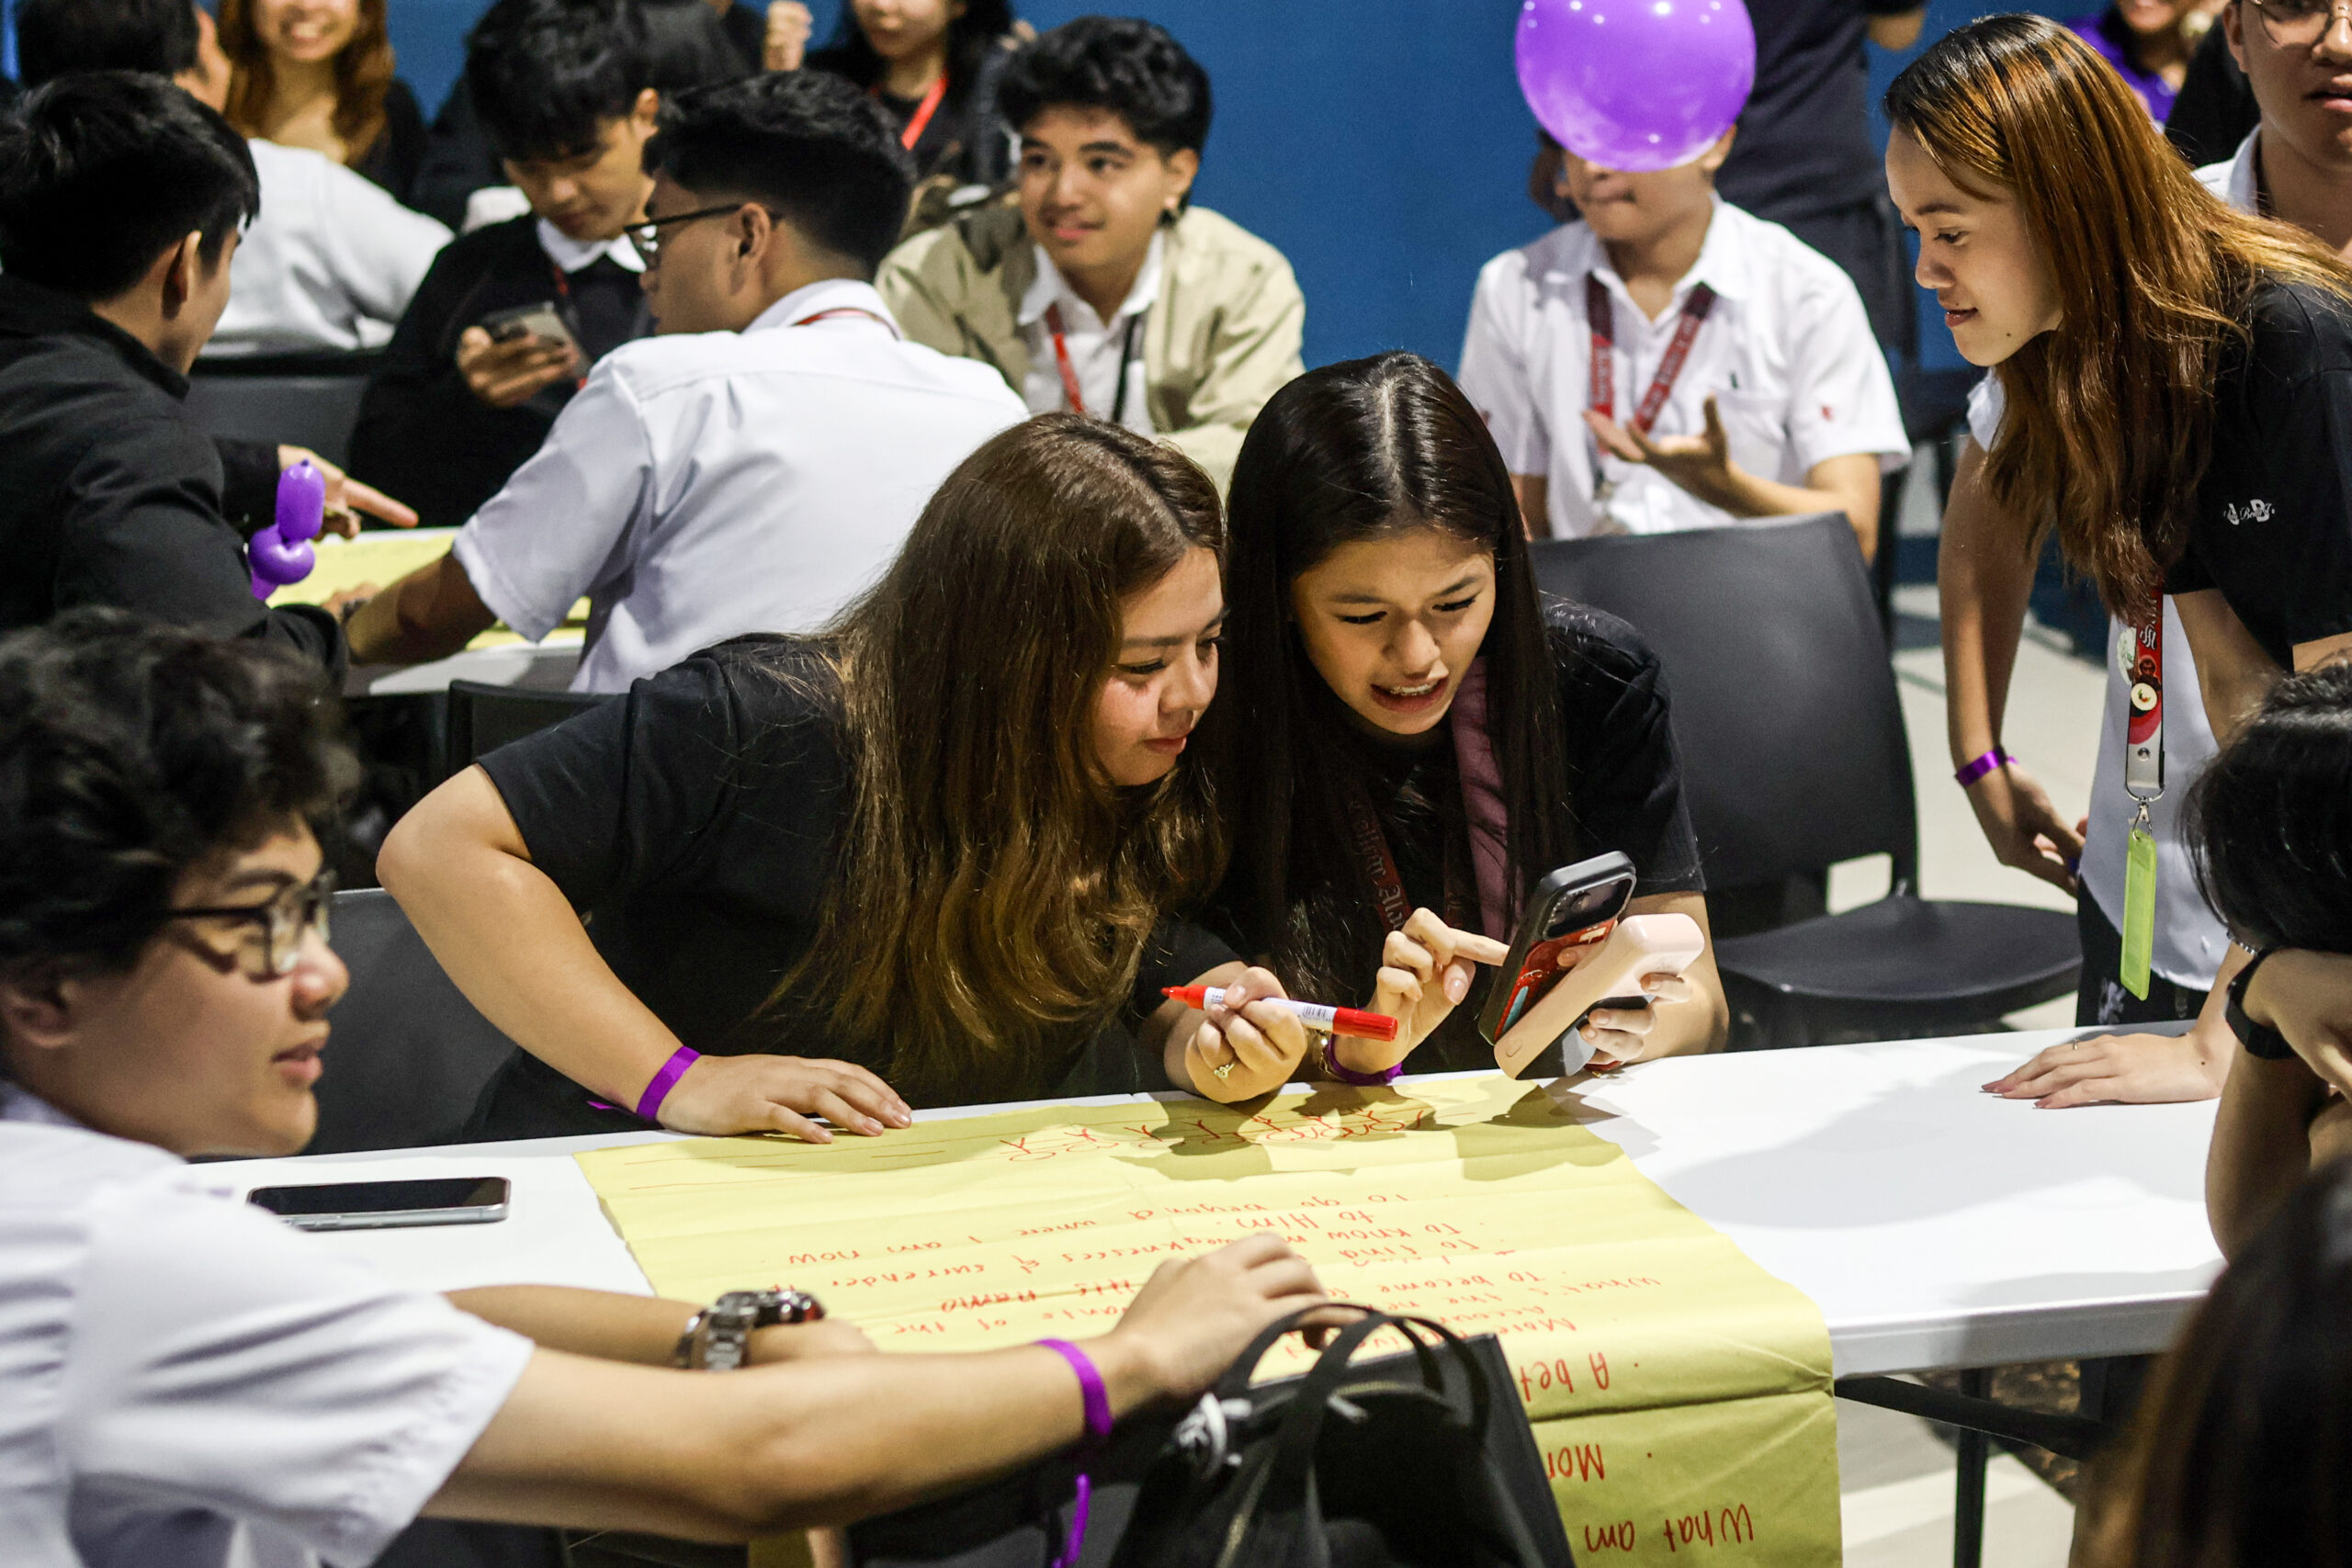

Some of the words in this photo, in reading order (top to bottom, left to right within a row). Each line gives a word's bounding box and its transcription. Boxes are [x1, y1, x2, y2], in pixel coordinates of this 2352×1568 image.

[1338, 1210, 1374, 1224] to
[1013, 1219, 1097, 1237] where
[1327, 1226, 1411, 1244] know
[1424, 1223, 1461, 1235] To
[886, 1240, 942, 1255] am
[1440, 1239, 1479, 1253] To
[788, 1248, 861, 1266] now
[831, 1262, 985, 1288] surrender
[1375, 1273, 1494, 1295] become
[1508, 1270, 1545, 1283] To
[1040, 1304, 1128, 1322] ants
[892, 1320, 946, 1336] the
[1490, 1315, 1577, 1337] More
[1589, 1352, 1610, 1391] A
[1520, 1359, 1574, 1403] bet
[1584, 1520, 1635, 1553] am
[1663, 1503, 1754, 1552] What
